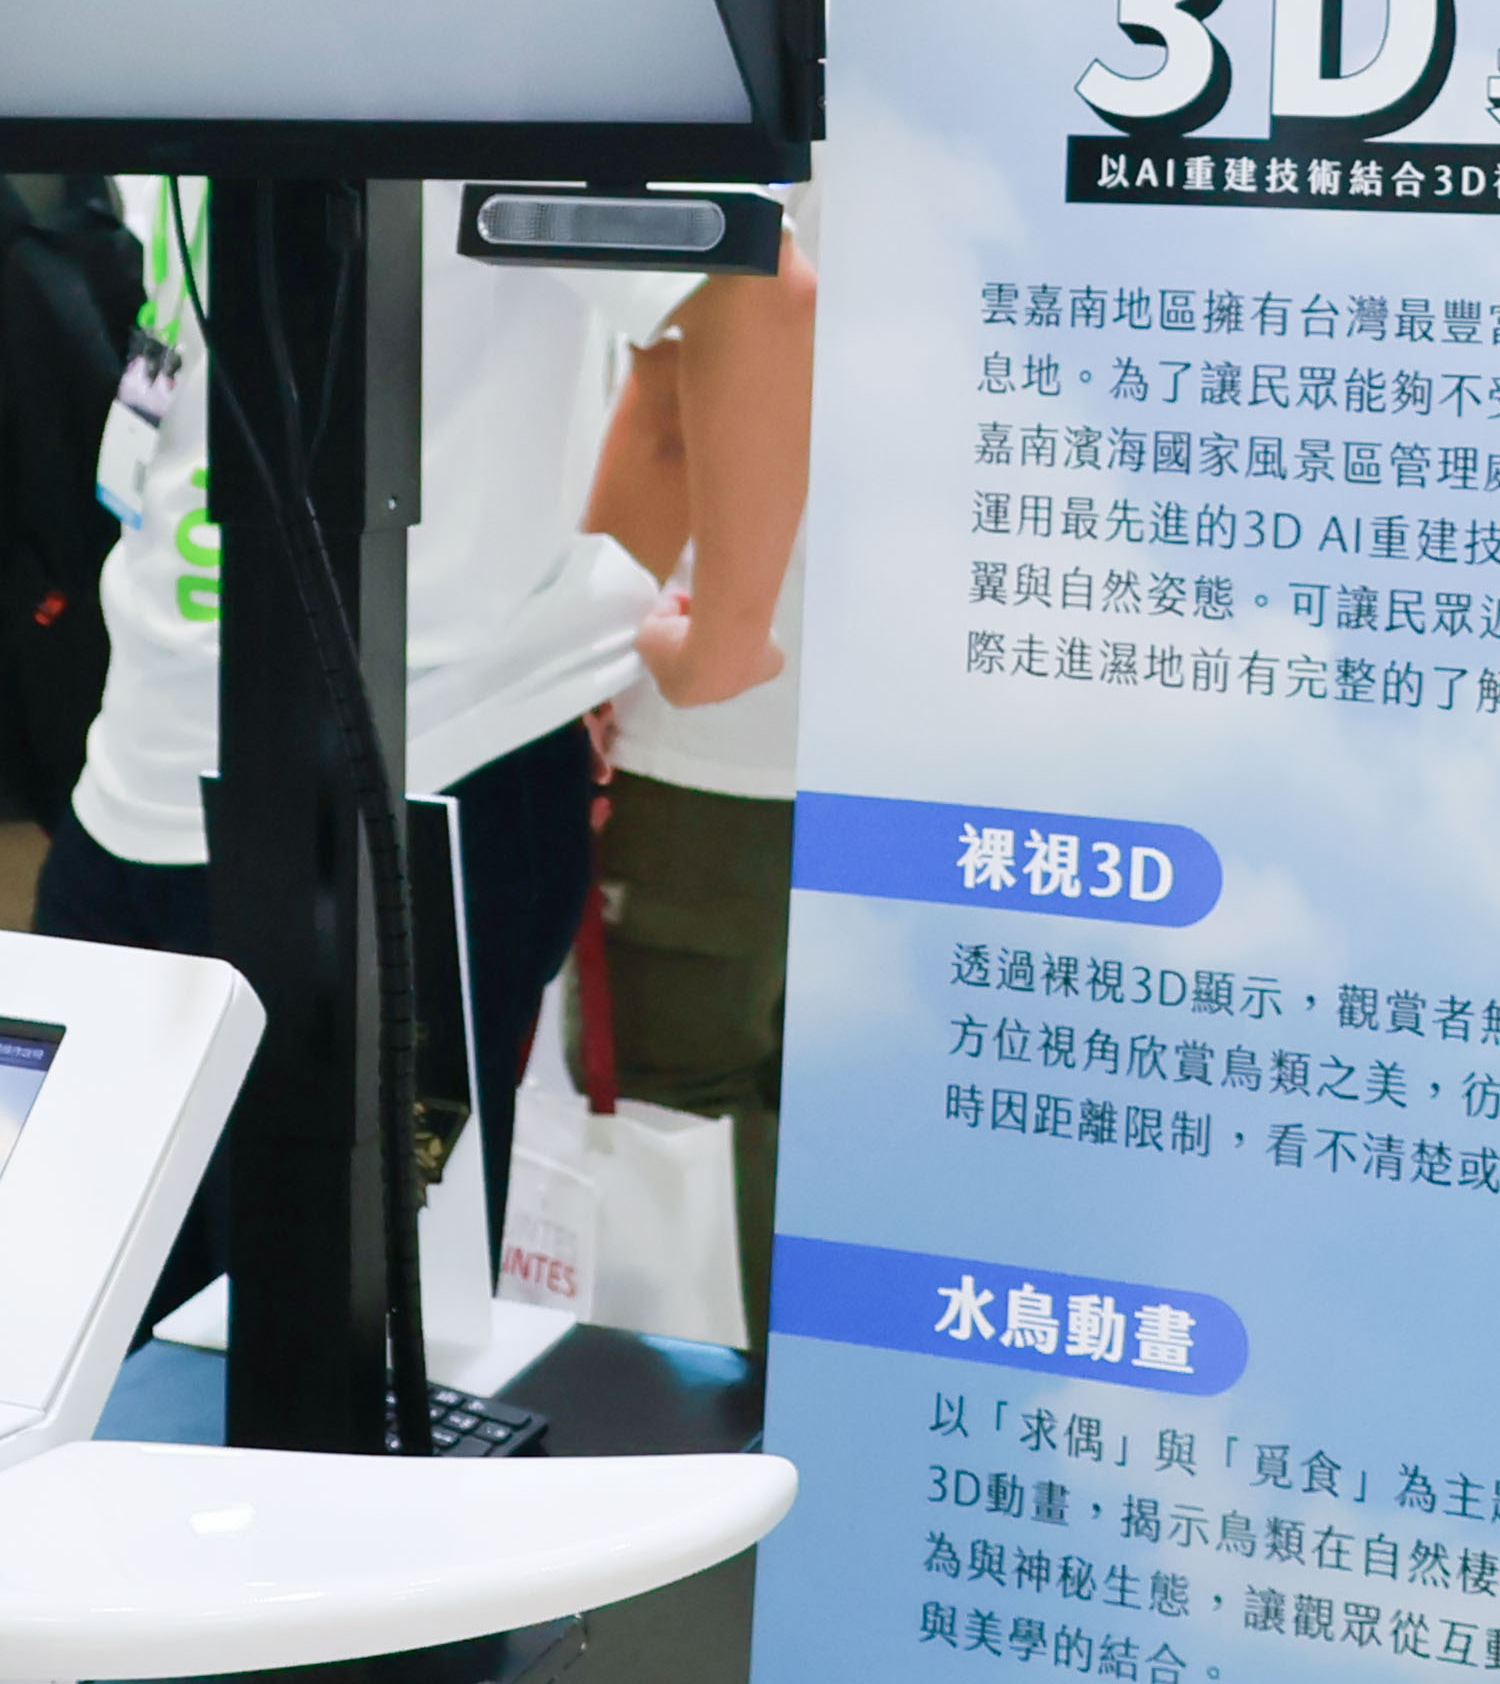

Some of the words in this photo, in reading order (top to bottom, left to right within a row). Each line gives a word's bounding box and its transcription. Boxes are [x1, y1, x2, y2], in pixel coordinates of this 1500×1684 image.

[956, 822, 1176, 903] 裸視3D
[935, 1275, 1199, 1376] 水鳥動畫
